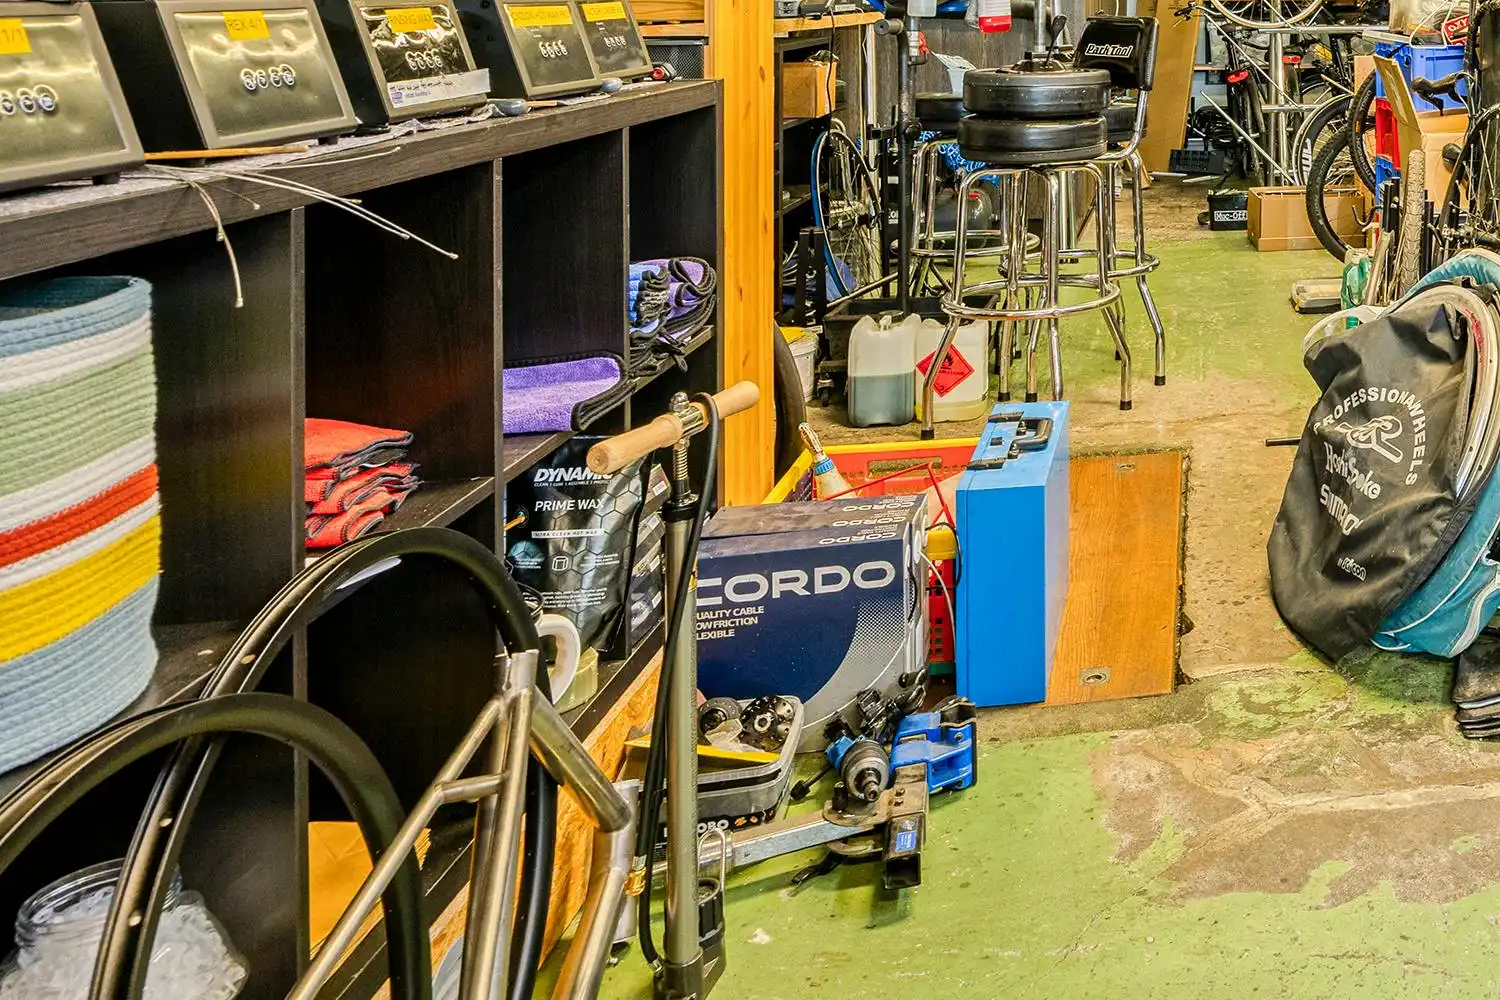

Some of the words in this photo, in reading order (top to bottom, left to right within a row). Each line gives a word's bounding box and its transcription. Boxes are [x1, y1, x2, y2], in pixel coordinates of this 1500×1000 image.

[1085, 43, 1108, 56] Park
[1109, 44, 1133, 58] Tool
[1215, 210, 1248, 221] Muc-Off
[534, 499, 576, 512] PRIME
[578, 498, 605, 510] WAX
[843, 501, 915, 511] CORDO
[832, 516, 907, 527] CORDO
[819, 531, 897, 544] CORDO
[696, 560, 896, 607] CORDO
[696, 609, 731, 621] UALITY
[733, 606, 765, 617] CABLE
[696, 622, 714, 632] OW
[713, 617, 759, 629] FRICTION
[696, 629, 735, 641] LEXIBLE
